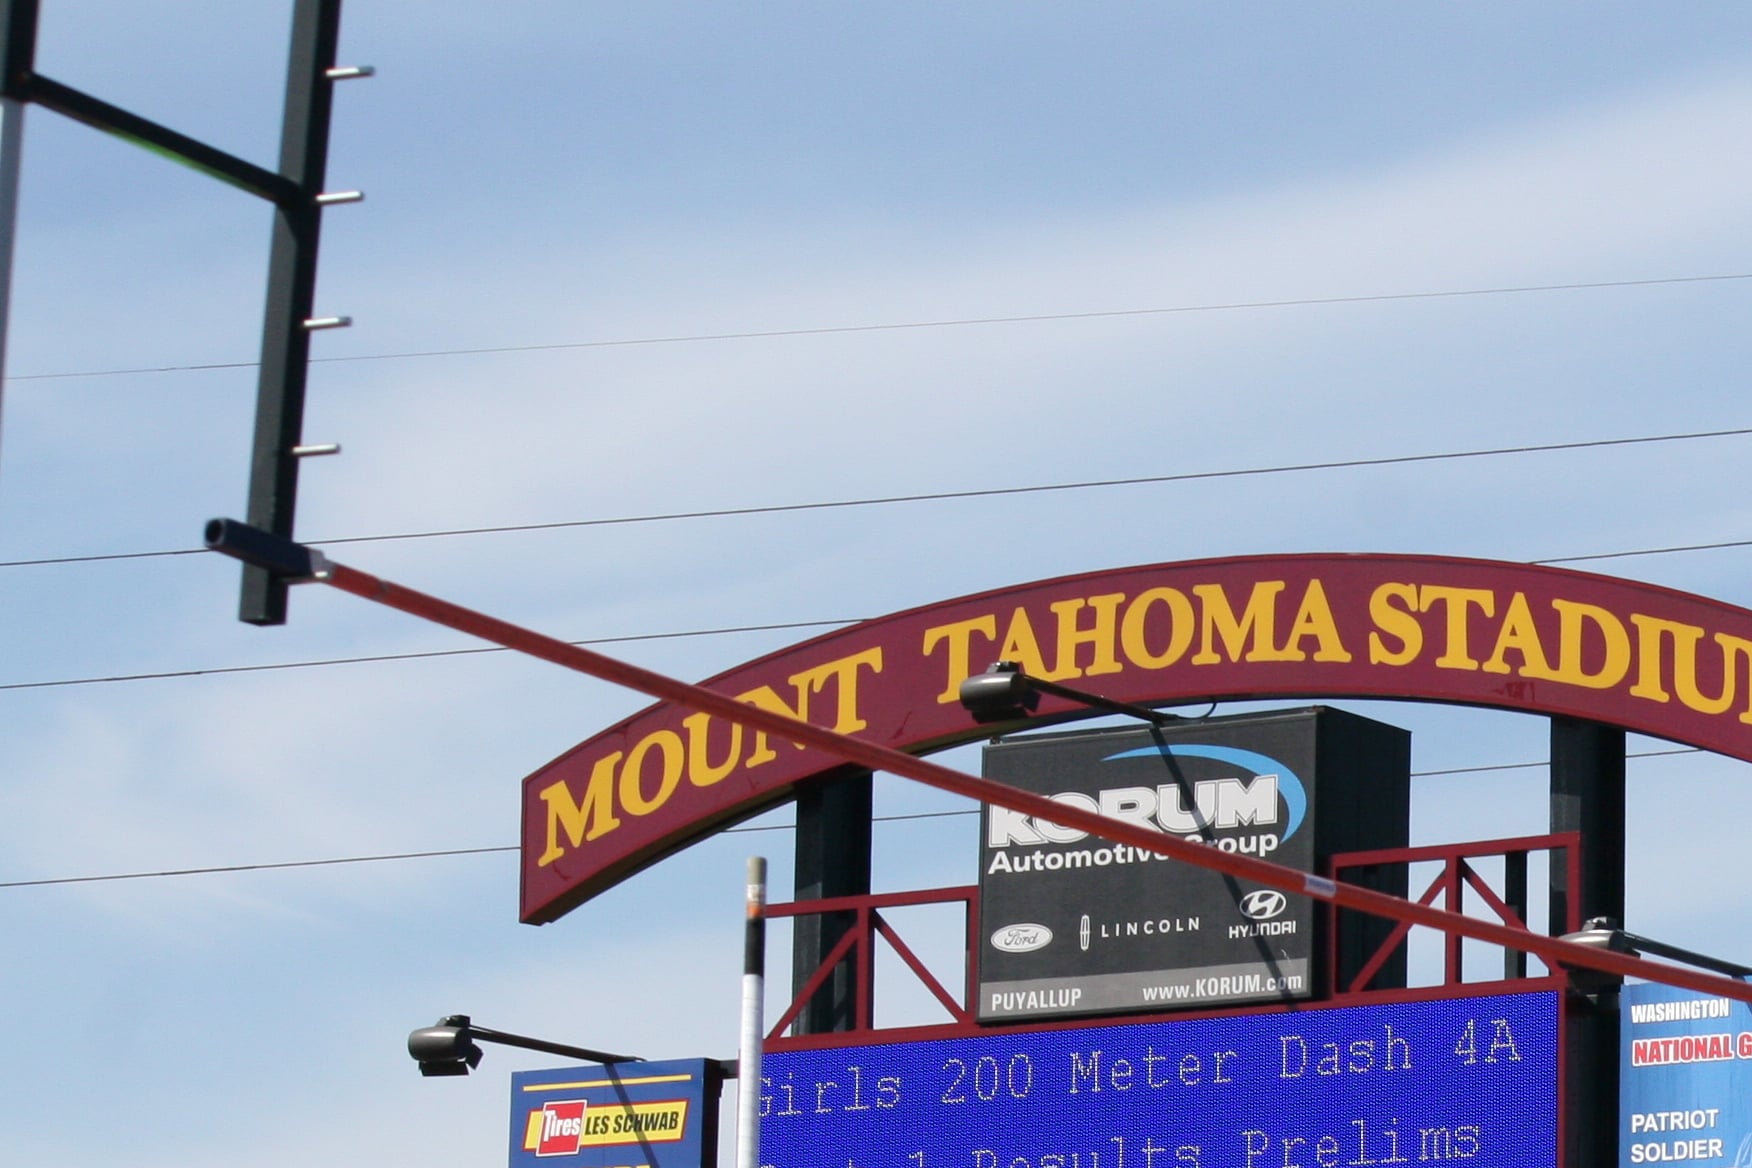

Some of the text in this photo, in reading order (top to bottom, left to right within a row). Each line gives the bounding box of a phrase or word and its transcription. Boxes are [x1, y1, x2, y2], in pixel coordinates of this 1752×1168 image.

[538, 646, 882, 867] MOUNT
[923, 578, 1352, 704] TAHOMA
[988, 774, 1279, 848] KORUM
[1003, 917, 1296, 946] Ford LINCOLN HYUNDAI
[991, 974, 1302, 1011] PUYALLUP www.KORUM.com
[1631, 998, 1730, 1023] WASHINGTON
[1633, 1034, 1733, 1066] NATIONAL
[759, 1018, 1521, 1116] Girls 200 Meter Dash 4A
[543, 1110, 679, 1142] Tires LES SCHWAB
[1631, 1108, 1719, 1133] PATRIOT
[1631, 1138, 1723, 1163] SOLDIER
